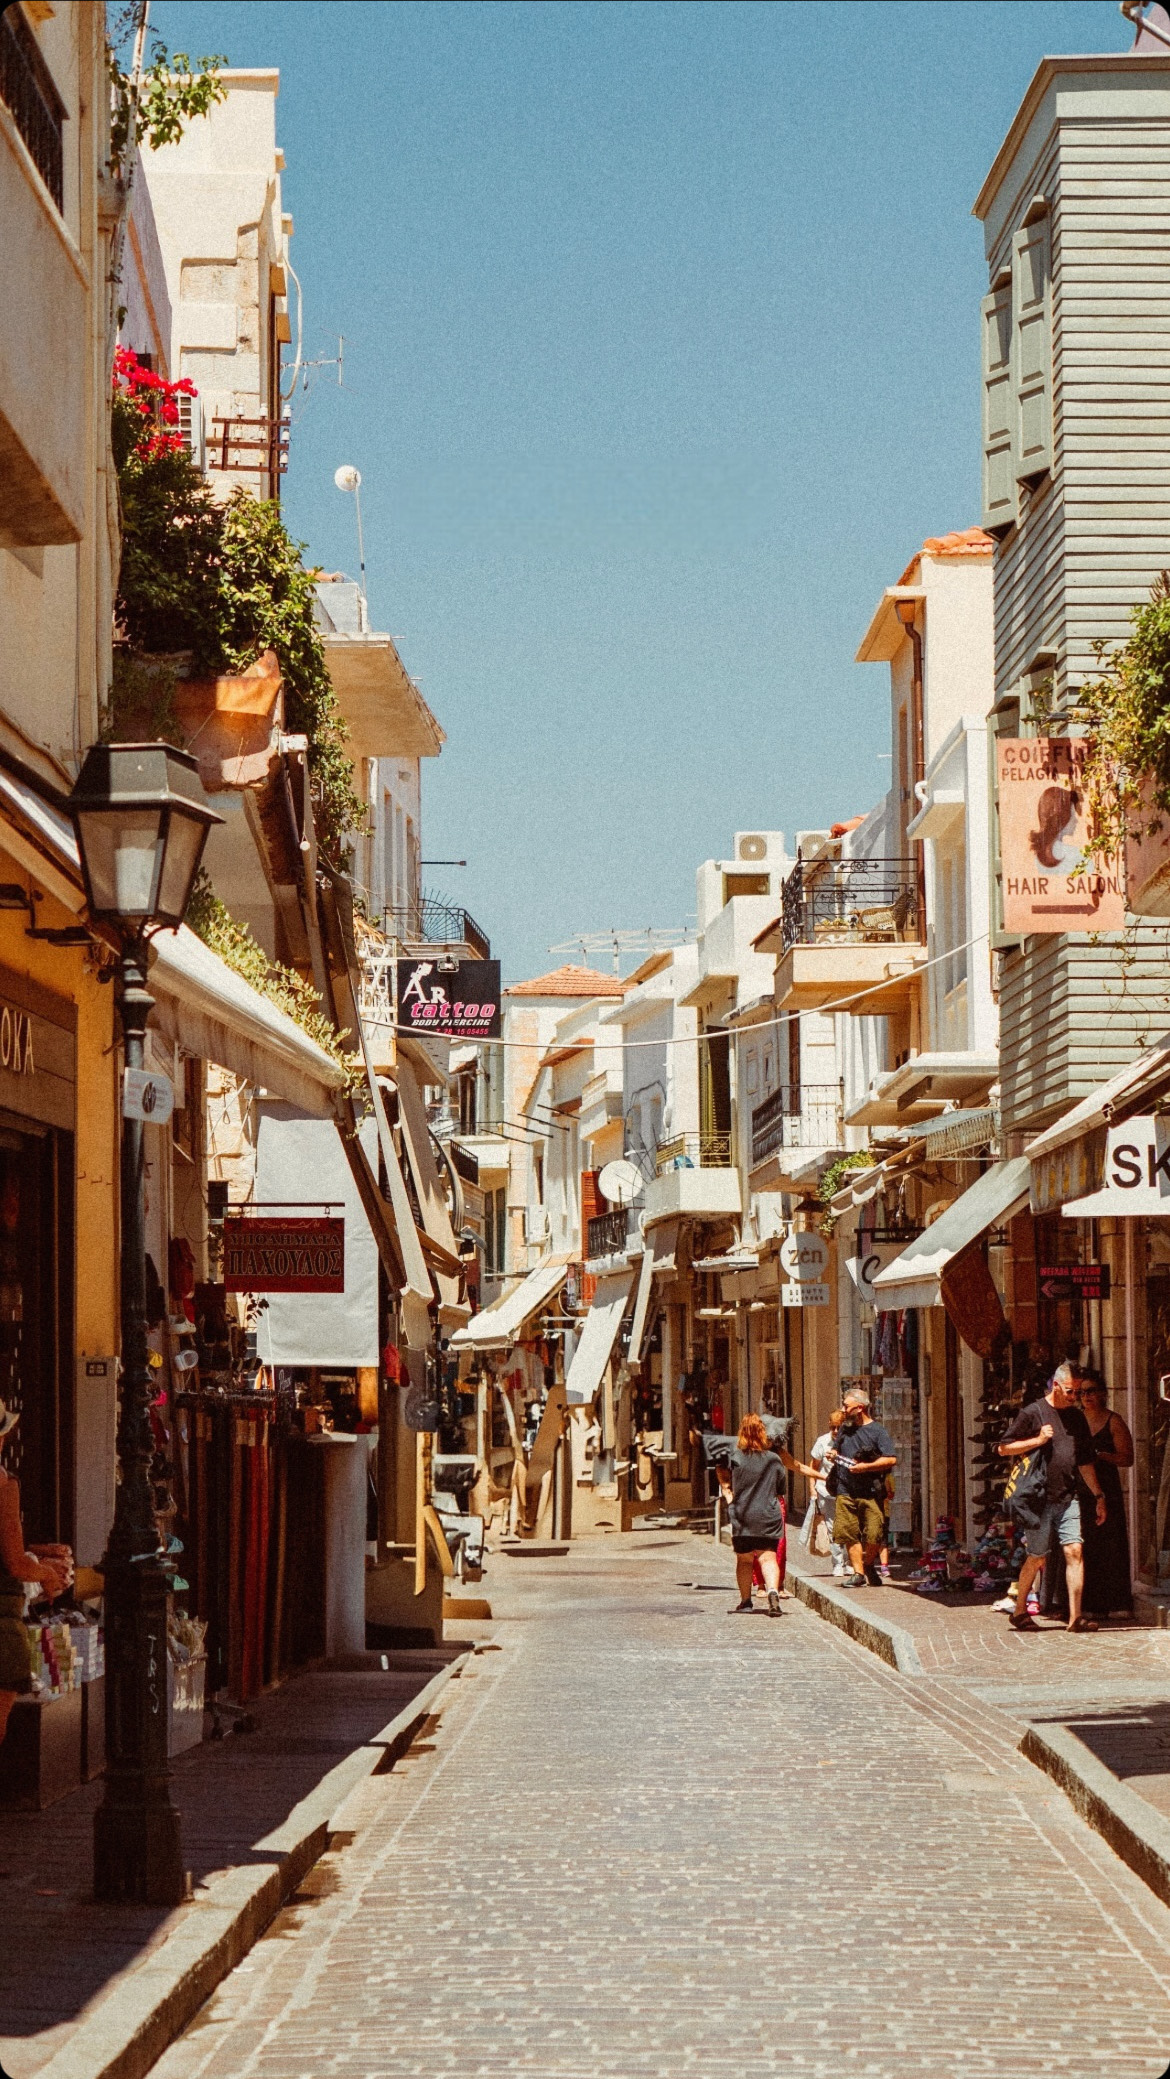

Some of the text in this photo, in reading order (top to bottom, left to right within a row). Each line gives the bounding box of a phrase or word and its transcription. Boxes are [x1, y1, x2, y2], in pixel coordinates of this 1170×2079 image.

[1001, 767, 1060, 782] PELAGIA
[1007, 876, 1118, 895] HAIR SALON
[410, 1001, 496, 1018] tattoo
[411, 1018, 441, 1026] BODY
[1101, 1144, 1170, 1190] SK
[229, 1233, 342, 1246] ΥΠΟΔΗΜΑΤΑ
[228, 1248, 342, 1277] ΠΑΧΟΥΛΟΣ
